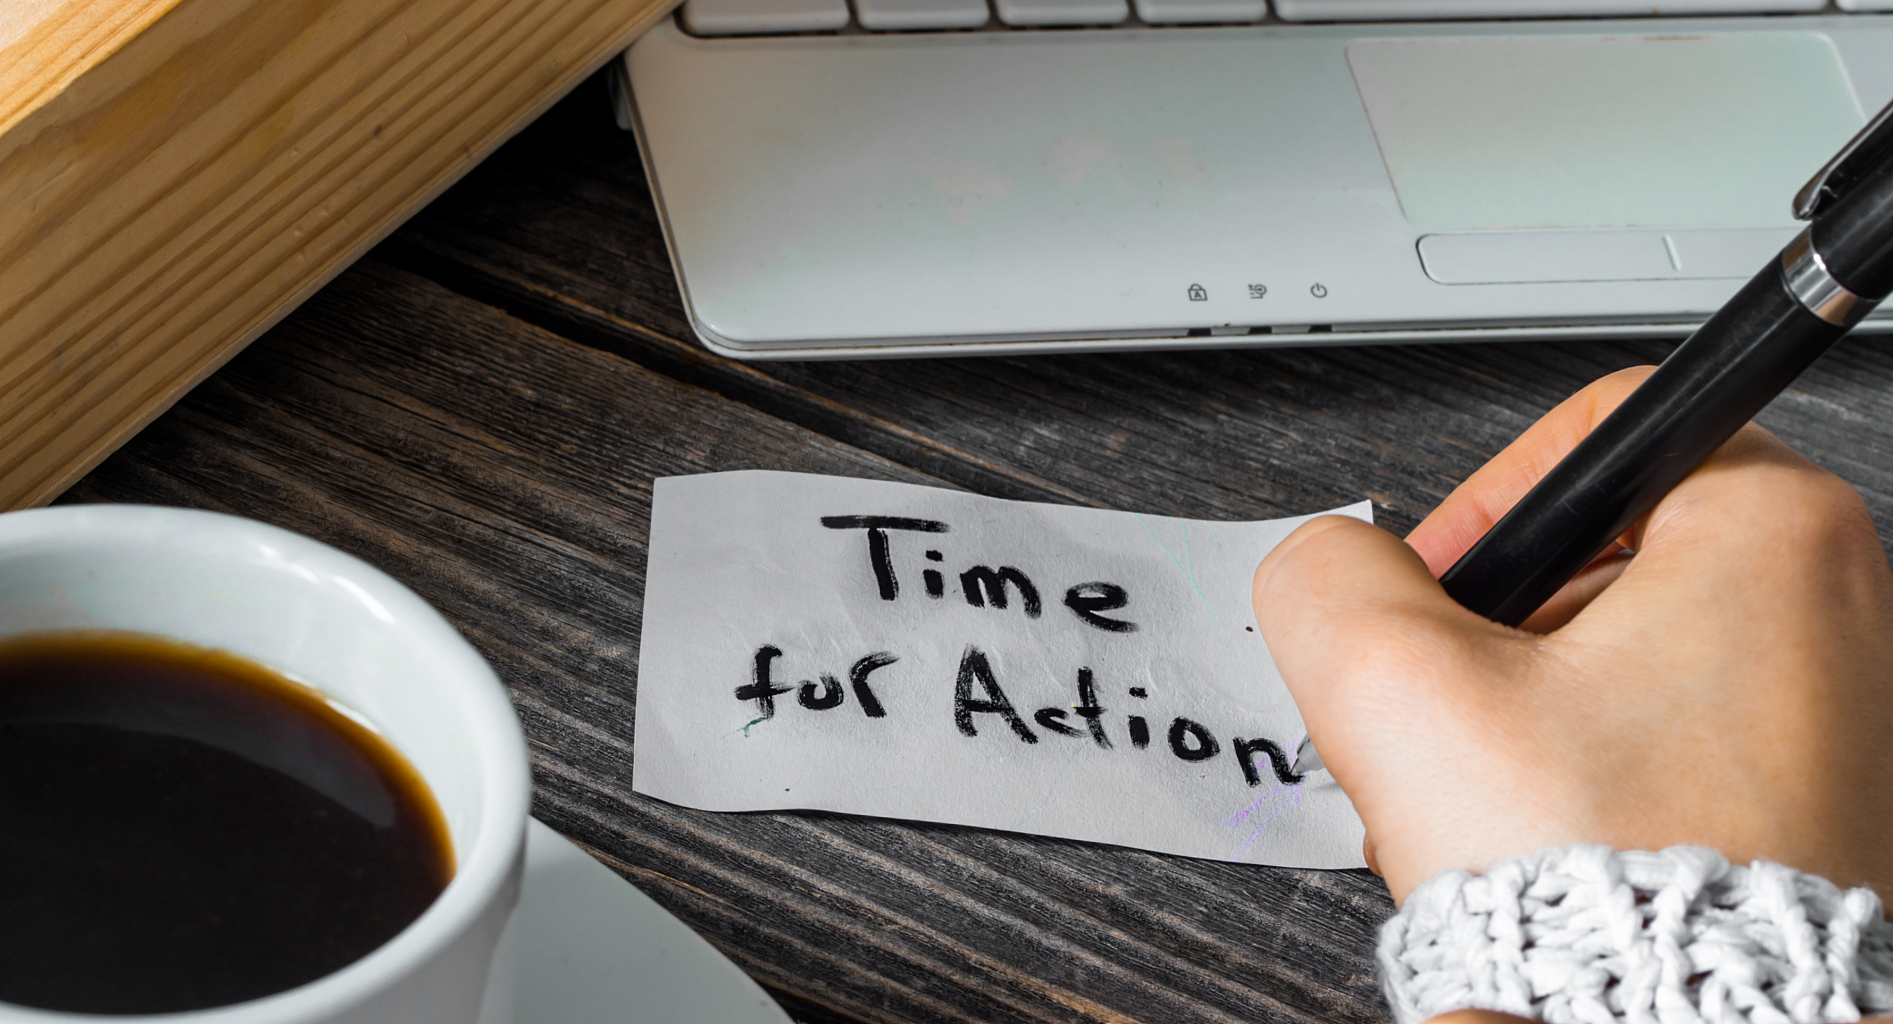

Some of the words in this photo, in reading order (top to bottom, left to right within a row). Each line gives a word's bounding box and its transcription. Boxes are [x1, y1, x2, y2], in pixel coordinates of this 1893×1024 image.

[820, 513, 1138, 633] Time
[735, 644, 900, 719] for
[954, 644, 1306, 787] Action
